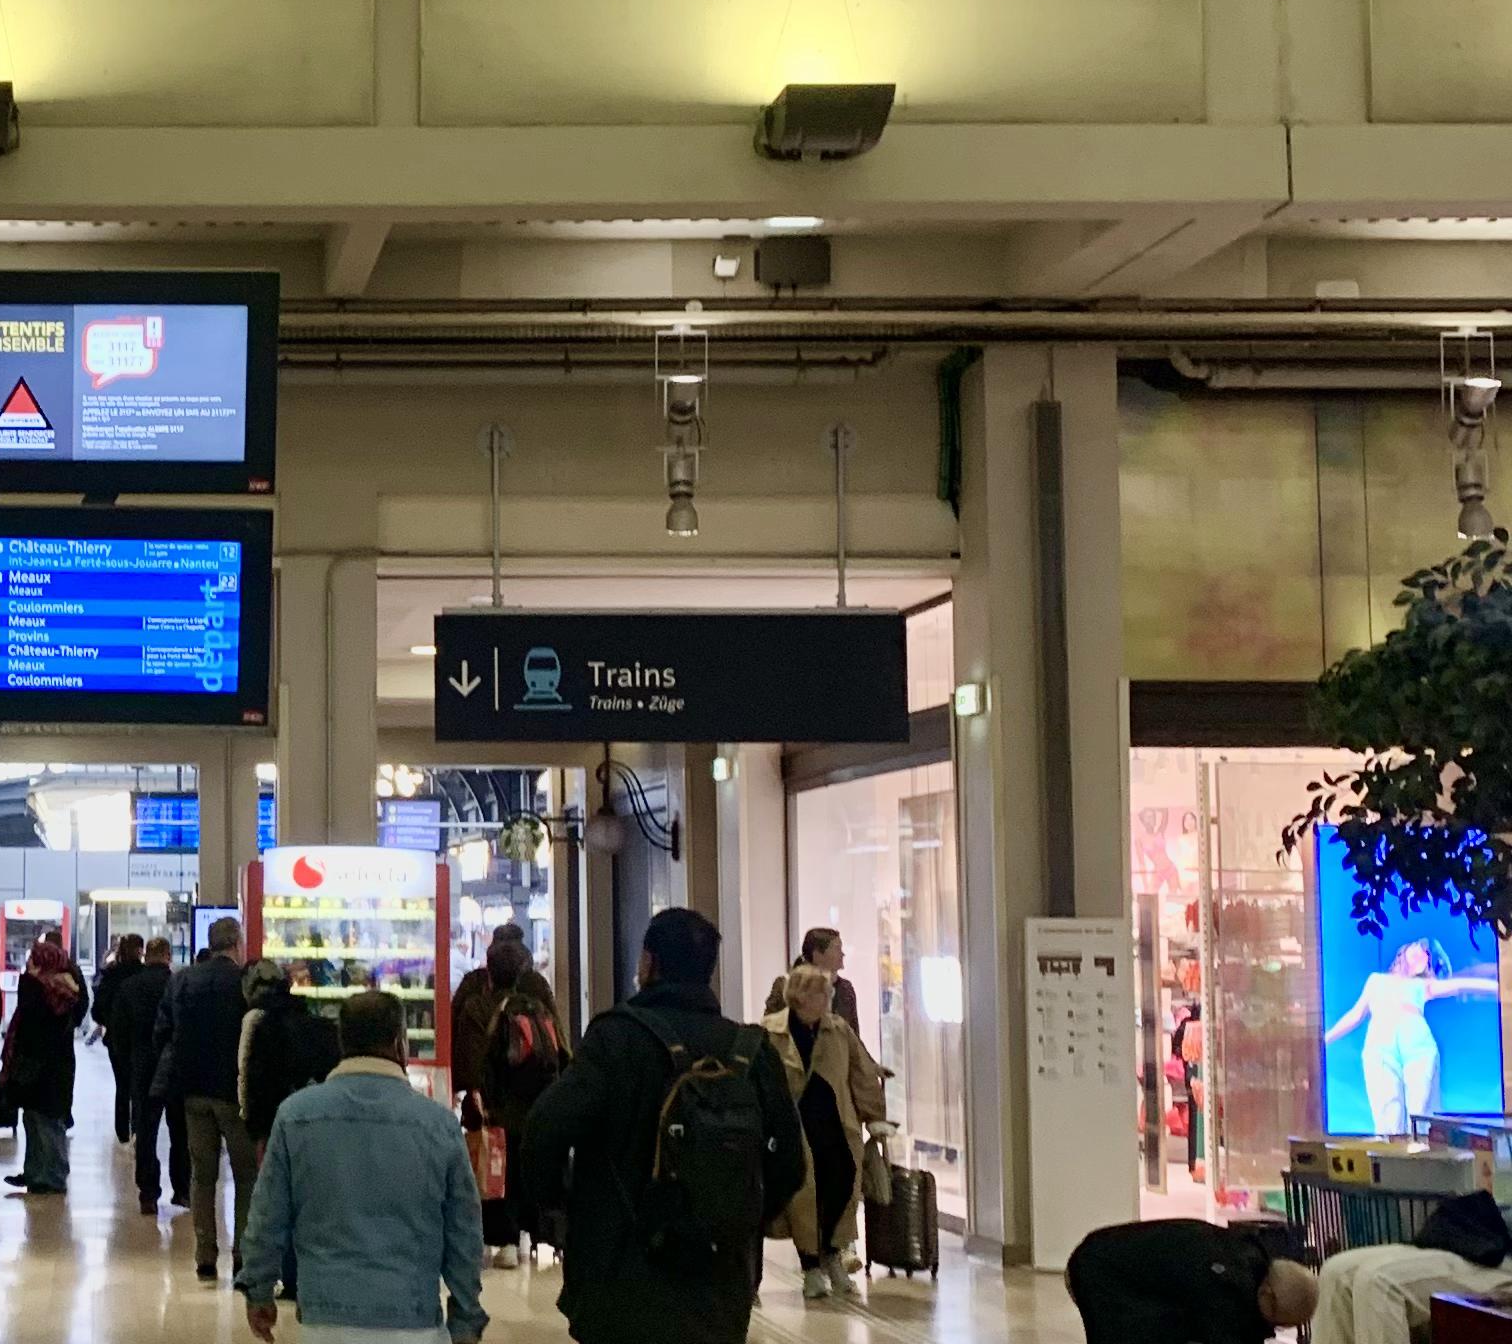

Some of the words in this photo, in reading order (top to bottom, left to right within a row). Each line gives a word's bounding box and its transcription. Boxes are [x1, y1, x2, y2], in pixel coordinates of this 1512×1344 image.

[9, 541, 111, 556] Château-Thierry
[60, 556, 71, 567] La
[9, 572, 50, 584] Meaux
[9, 586, 43, 596] Meaux
[9, 602, 84, 613] Coulommiers
[8, 616, 45, 627] Meaux
[9, 630, 49, 642] Provins
[8, 644, 98, 659] Château-Thierry
[8, 659, 45, 671] Meaux
[8, 673, 83, 687] Coulommiers
[588, 661, 677, 688] Trains
[590, 694, 632, 711] Trains
[649, 694, 685, 713] Züge
